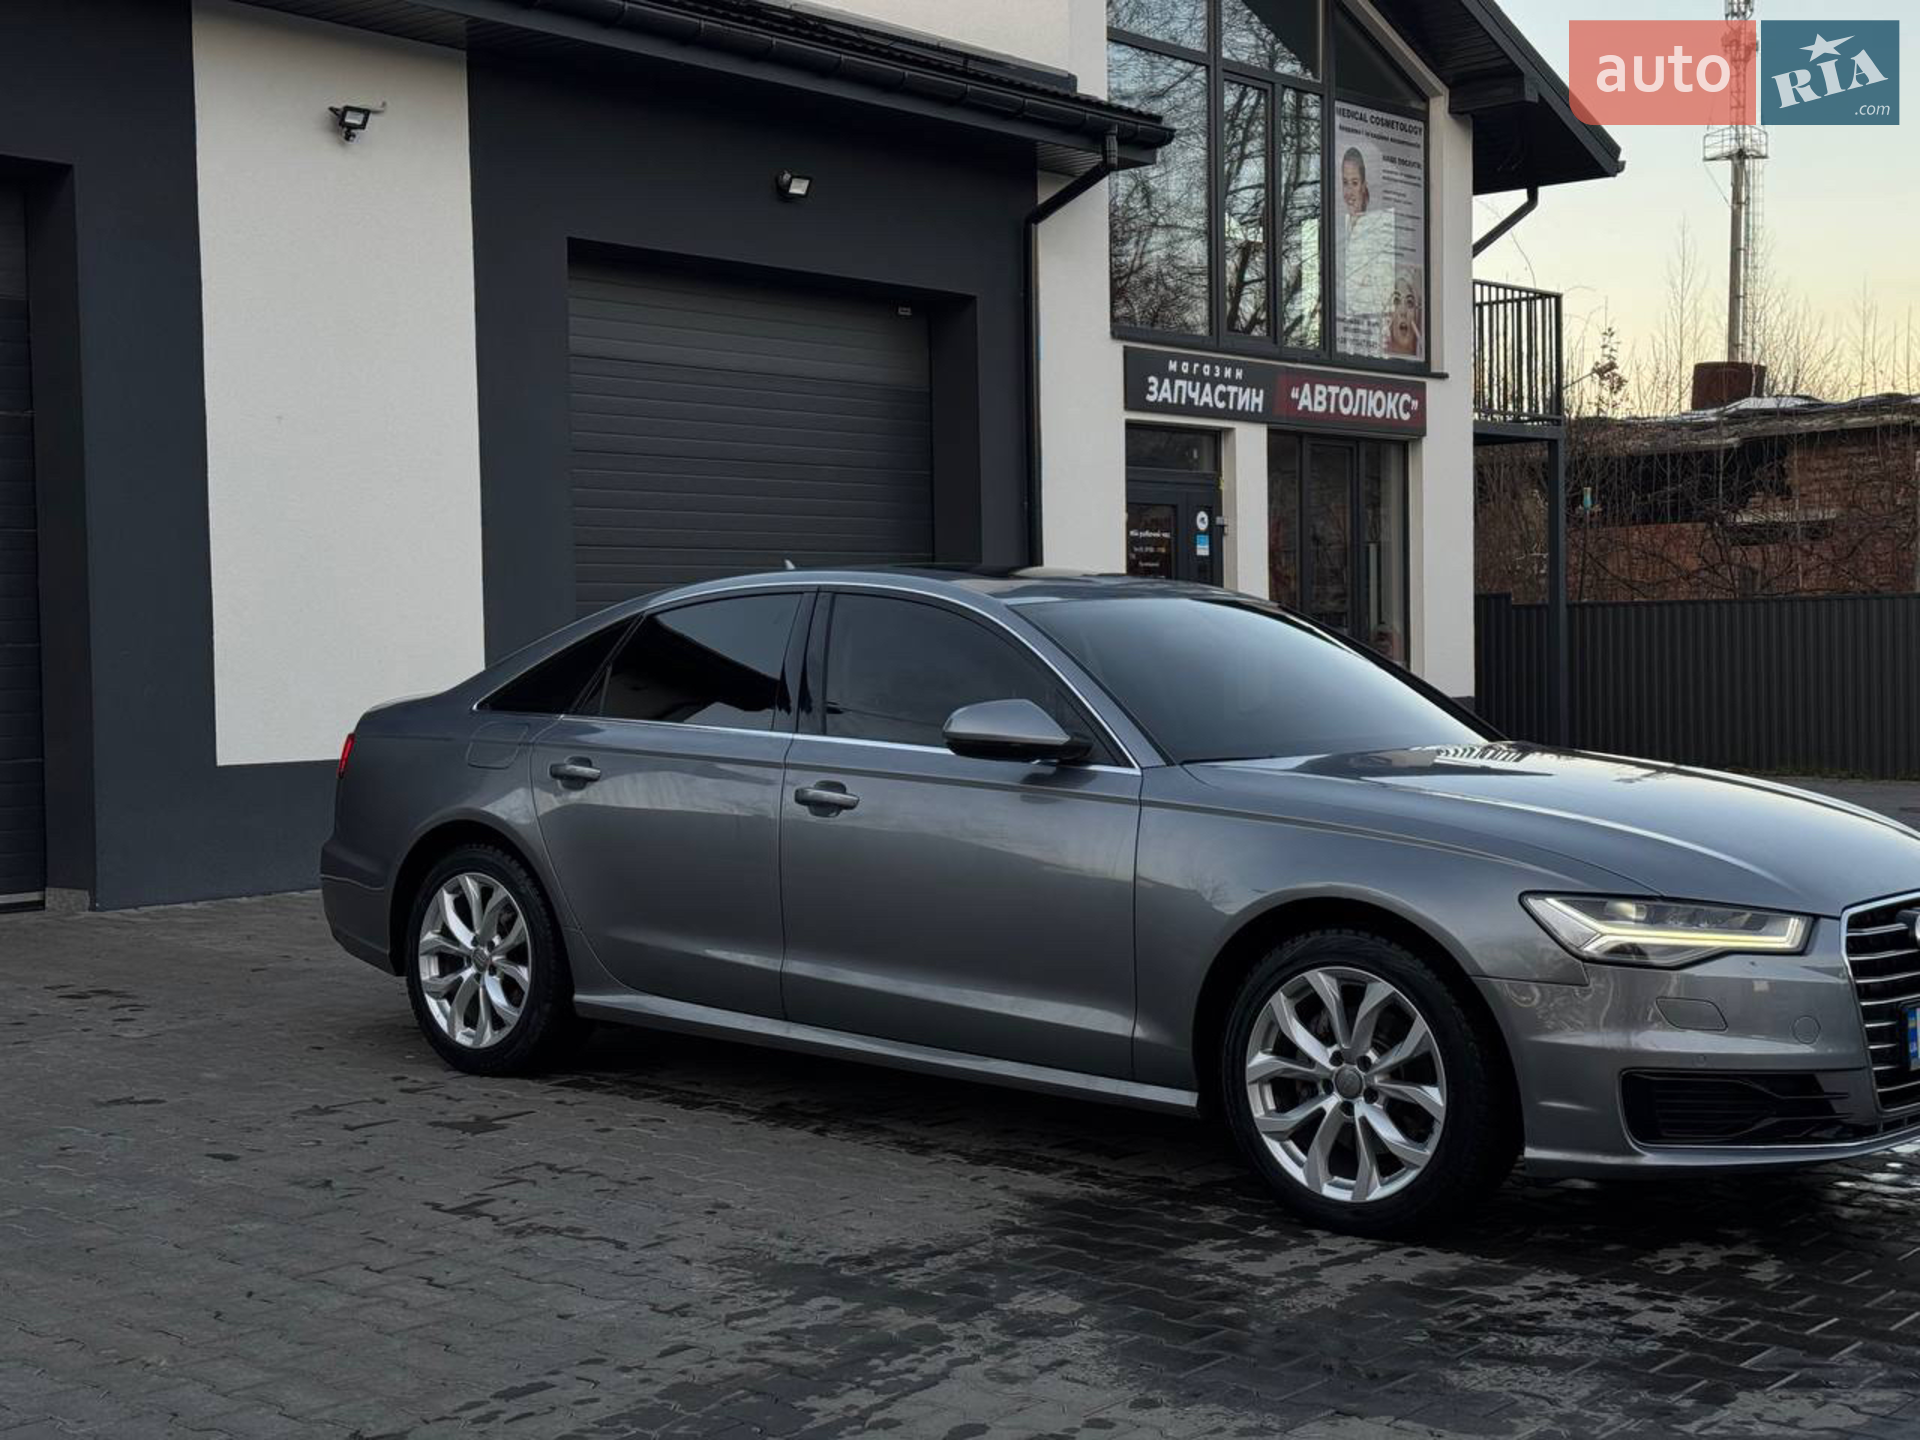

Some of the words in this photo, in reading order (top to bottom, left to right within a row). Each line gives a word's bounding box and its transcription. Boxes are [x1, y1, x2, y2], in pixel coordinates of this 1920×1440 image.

[1335, 106, 1368, 124] MEDICAL
[1369, 114, 1422, 136] COSMETOLOGY
[1168, 359, 1243, 380] магазин
[1145, 376, 1264, 413] ЗАПЧАСТИН
